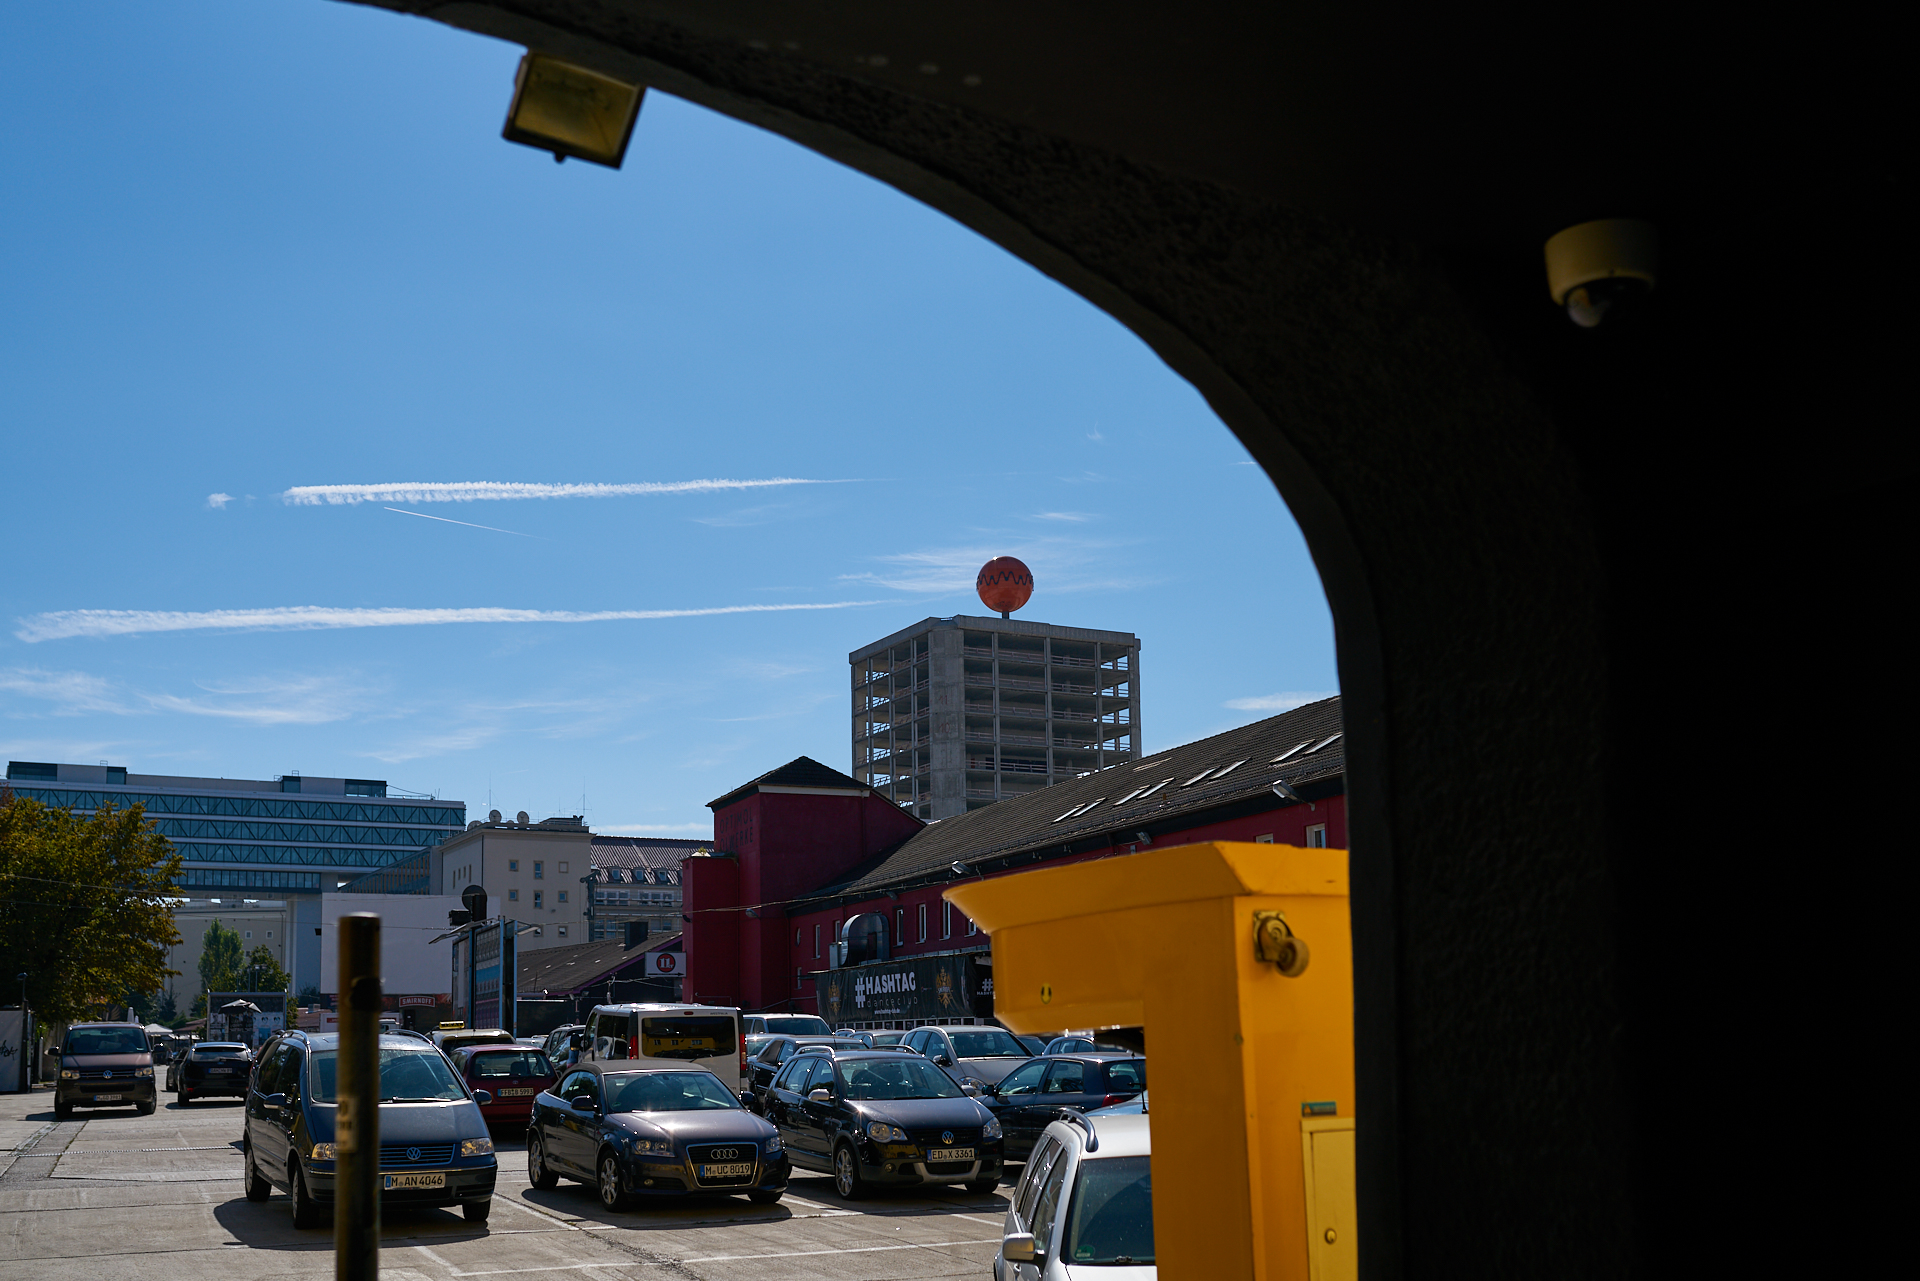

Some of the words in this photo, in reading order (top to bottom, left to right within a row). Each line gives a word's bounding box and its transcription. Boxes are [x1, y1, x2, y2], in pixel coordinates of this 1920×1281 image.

[719, 806, 753, 834] OPTIMOL
[855, 971, 917, 1008] #HASHTAG
[402, 997, 433, 1005] SMIRNOFF
[419, 1175, 443, 1186] 4046
